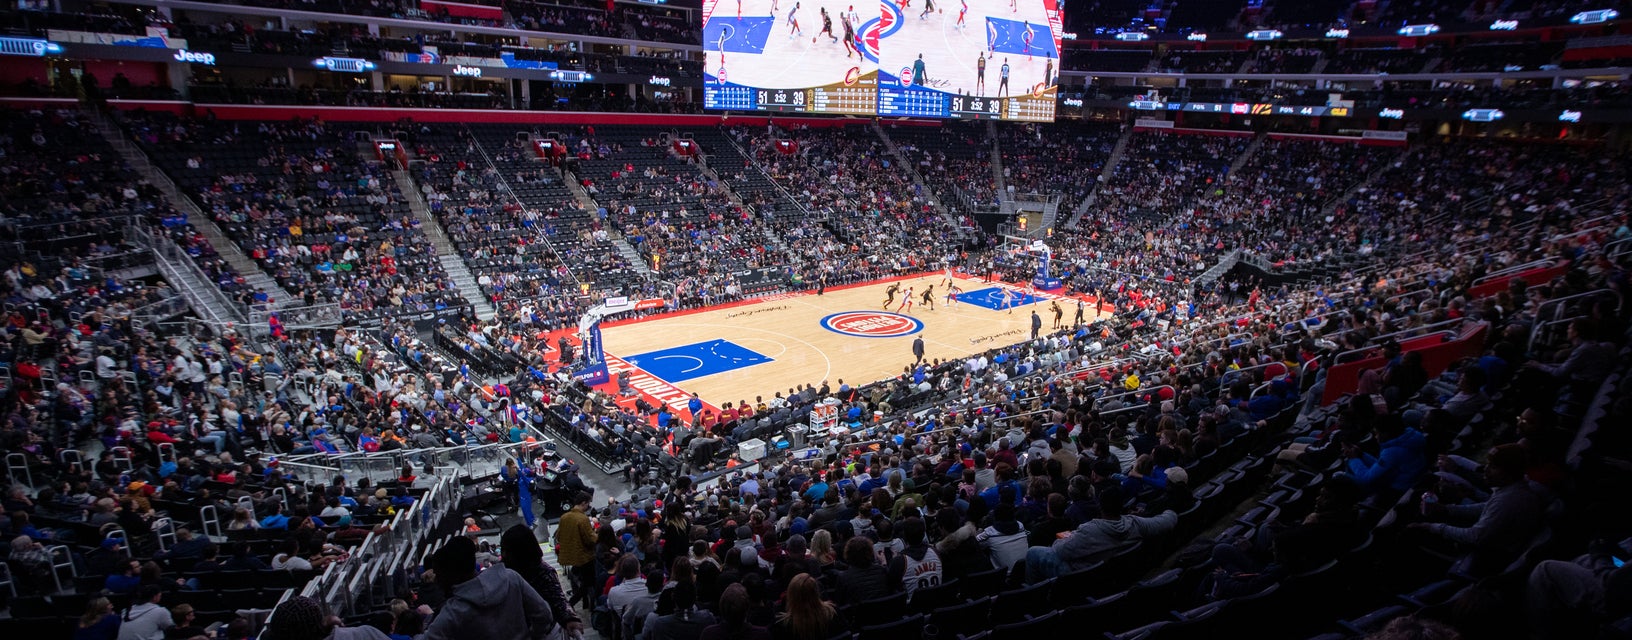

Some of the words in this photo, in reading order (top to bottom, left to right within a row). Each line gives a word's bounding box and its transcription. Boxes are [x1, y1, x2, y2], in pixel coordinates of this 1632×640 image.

[1490, 19, 1519, 31] Jeep
[1187, 32, 1207, 42] Jeep
[1325, 27, 1350, 39] Jeep
[173, 49, 216, 65] Jeep
[453, 64, 482, 78] Jeep
[649, 75, 671, 87] Jeep
[758, 91, 768, 104] 51
[774, 93, 787, 103] 3:52
[793, 91, 804, 105] 39
[1063, 97, 1083, 107] Jeep
[952, 98, 963, 111] 51
[970, 101, 983, 111] 3:52
[988, 100, 1000, 113] 39
[1300, 107, 1312, 115] 44
[1379, 107, 1404, 119] Jeep
[914, 561, 937, 576] JAMES
